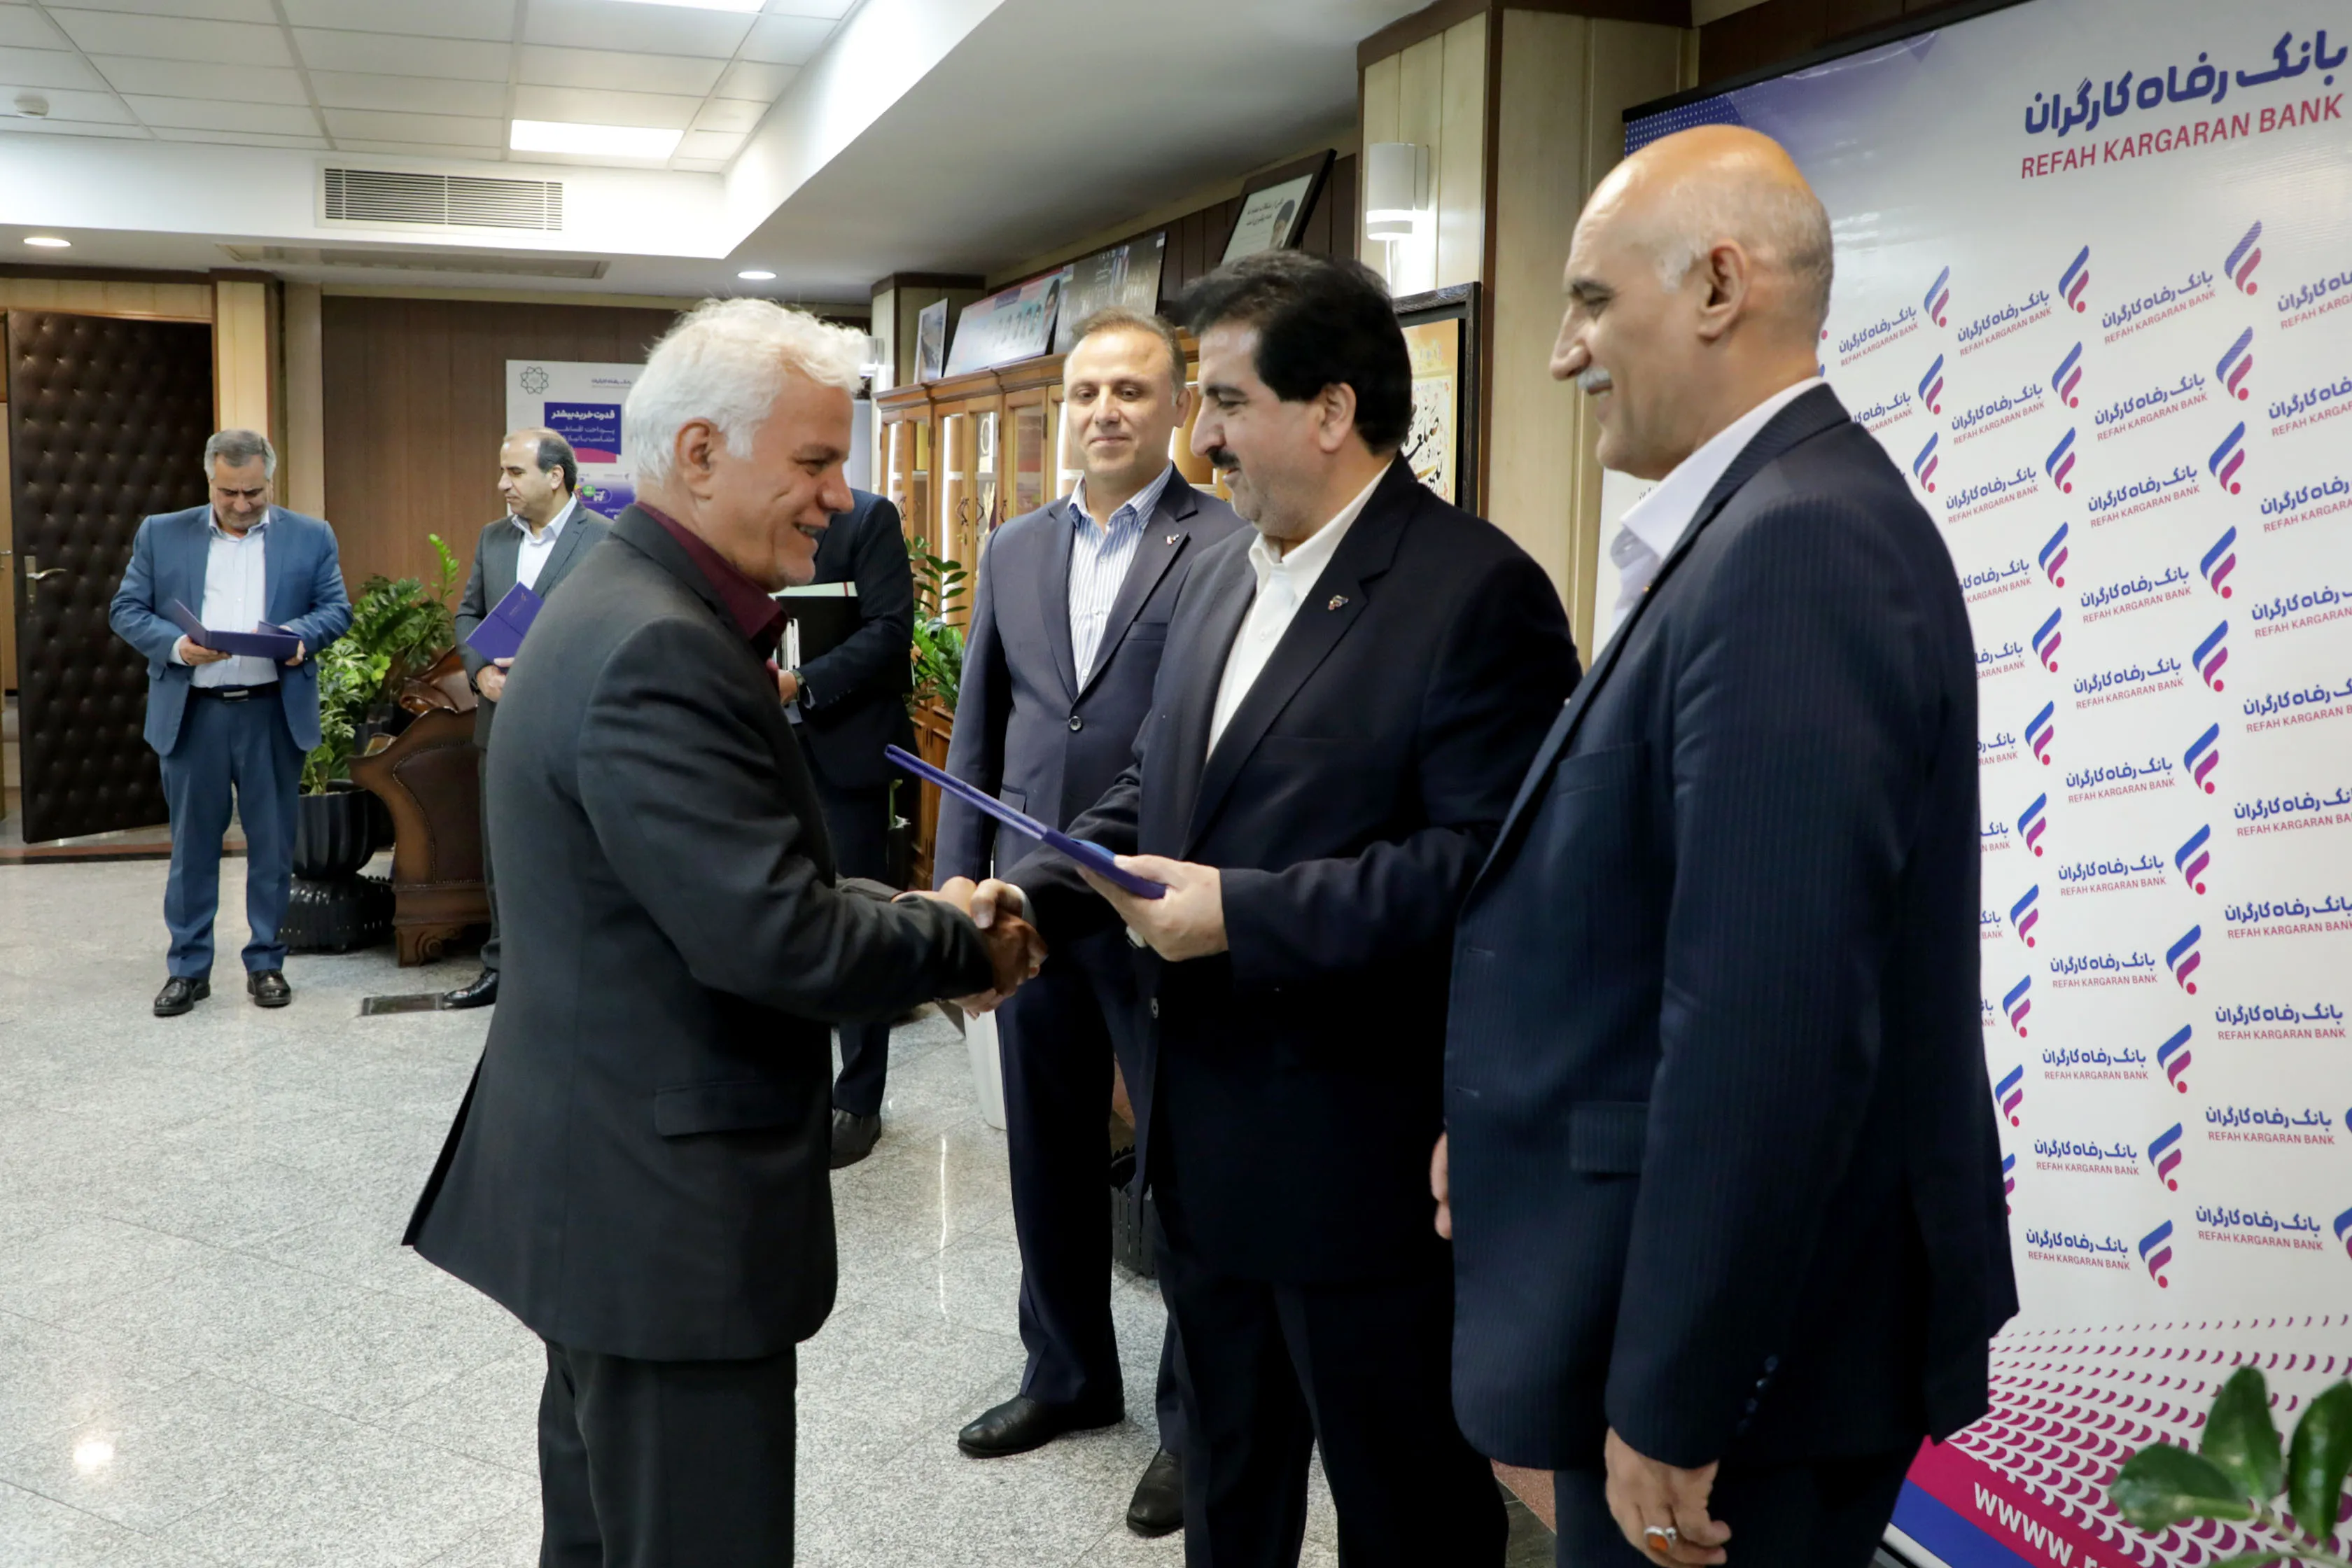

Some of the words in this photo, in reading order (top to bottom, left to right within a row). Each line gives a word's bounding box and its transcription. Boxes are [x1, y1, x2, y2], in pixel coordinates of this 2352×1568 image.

[2236, 29, 2348, 87] بانک
[2136, 52, 2228, 109] رفاه
[2025, 71, 2133, 137] کارگران
[2022, 144, 2096, 178] REFAH
[2104, 113, 2250, 162] KARGARAN
[2260, 93, 2344, 133] BANK
[2177, 271, 2213, 295] بانک
[2020, 290, 2050, 312] بانک
[2143, 286, 2176, 310] رفاه
[2278, 278, 2327, 312] کارگران
[1891, 307, 1917, 326] بانک
[1991, 304, 2019, 325] رفاه
[2102, 298, 2142, 328] کارگران
[2105, 326, 2134, 344] REFAH
[2136, 302, 2188, 330] KARGARAN
[2188, 289, 2216, 307] BANK
[2281, 308, 2317, 329] REFAH
[1868, 319, 1891, 339] رفاه
[1958, 315, 1991, 342] کارگران
[1960, 340, 1984, 357] REFAH
[1984, 318, 2028, 346] KARGARAN
[2029, 307, 2052, 323] BANK
[1839, 328, 1868, 353] کارگران
[1840, 351, 1861, 366] REFAH
[1861, 332, 1898, 356] KARGARAN
[1899, 321, 1919, 336] BANK
[2013, 384, 2043, 404] بانک
[2169, 374, 2205, 396] بانک
[1985, 396, 2012, 416] رفاه
[2136, 387, 2168, 409] رفاه
[2269, 388, 2317, 419] کارگران
[1952, 405, 1984, 430] کارگران
[2095, 398, 2134, 425] کارگران
[2098, 424, 2126, 440] REFAH
[2128, 404, 2179, 429] KARGARAN
[2180, 393, 2208, 409] BANK
[1954, 430, 1978, 444] REFAH
[1978, 412, 2022, 434] KARGARAN
[2022, 401, 2045, 416] BANK
[2272, 418, 2306, 437] REFAH
[2008, 468, 2036, 486] بانک
[2162, 465, 2197, 486] بانک
[1980, 477, 2006, 496] رفاه
[2129, 477, 2160, 498] رفاه
[2311, 476, 2349, 499] رفاه
[1947, 486, 1979, 509] کارگران
[1948, 511, 1972, 524] REFAH
[1973, 493, 2016, 514] KARGARAN
[2017, 484, 2039, 498] BANK
[2089, 485, 2127, 511] کارگران
[2090, 512, 2120, 526] REFAH
[2121, 494, 2171, 517] KARGARAN
[2174, 484, 2200, 500] BANK
[2261, 486, 2309, 514] کارگران
[2263, 515, 2300, 532] REFAH
[1973, 568, 2000, 586] رفاه
[2001, 559, 2029, 577] بانک
[2155, 567, 2189, 586] بانک
[1967, 584, 2008, 603] KARGARAN
[2010, 578, 2032, 592] BANK
[2081, 583, 2120, 607] کارگران
[2121, 576, 2152, 596] رفاه
[2083, 610, 2112, 623] REFAH
[2113, 594, 2164, 615] KARGARAN
[2165, 587, 2191, 601] BANK
[2252, 594, 2299, 620] کارگران
[2301, 586, 2340, 608] رفاه
[2255, 622, 2290, 638] REFAH
[1994, 643, 2023, 659] بانک
[2114, 665, 2145, 683] رفاه
[2147, 658, 2181, 676] بانک
[2074, 671, 2112, 694] کارگران
[2076, 696, 2104, 709] REFAH
[2106, 685, 2156, 703] KARGARAN
[2157, 678, 2184, 691] BANK
[2244, 691, 2290, 715] کارگران
[2292, 685, 2331, 705] رفاه
[2246, 718, 2281, 732] REFAH
[2283, 706, 2344, 725] KARGARAN
[2106, 762, 2136, 780] رفاه
[2138, 757, 2173, 774] بانک
[2066, 767, 2104, 788] کارگران
[2068, 792, 2097, 803] REFAH
[2098, 783, 2148, 799] KARGARAN
[2149, 778, 2176, 790] BANK
[2234, 797, 2281, 820] کارگران
[2283, 792, 2320, 812] رفاه
[2237, 825, 2272, 836] REFAH
[2273, 816, 2334, 832] KARGARAN
[2059, 862, 2096, 882] کارگران
[2098, 858, 2129, 876] رفاه
[2130, 855, 2164, 873] بانک
[2061, 886, 2088, 896] REFAH
[2090, 879, 2138, 892] KARGARAN
[2140, 876, 2166, 888] BANK
[2225, 902, 2271, 923] کارگران
[2273, 899, 2310, 918] رفاه
[2227, 928, 2261, 939] REFAH
[2263, 923, 2323, 935] KARGARAN
[2050, 955, 2088, 974] کارگران
[2090, 953, 2120, 972] رفاه
[2122, 952, 2155, 971] بانک
[2052, 979, 2081, 988] REFAH
[2081, 976, 2131, 986] KARGARAN
[2131, 974, 2157, 985] BANK
[2216, 1004, 2261, 1026] کارگران
[2262, 1004, 2300, 1023] رفاه
[2302, 1002, 2343, 1025] بانک
[2218, 1030, 2251, 1040] REFAH
[2254, 1029, 2312, 1040] KARGARAN
[2315, 1028, 2346, 1039] BANK
[2043, 1048, 2079, 1066] کارگران
[2081, 1049, 2111, 1066] رفاه
[2113, 1048, 2146, 1068] بانک
[2045, 1071, 2072, 1079] REFAH
[2073, 1071, 2122, 1080] KARGARAN
[2122, 1070, 2149, 1080] BANK
[2206, 1106, 2251, 1127] کارگران
[2253, 1108, 2289, 1128] رفاه
[2291, 1109, 2332, 1131] بانک
[2208, 1131, 2241, 1141] REFAH
[2244, 1133, 2302, 1144] KARGARAN
[2304, 1135, 2334, 1145] BANK
[2034, 1140, 2071, 1158] کارگران
[2073, 1142, 2103, 1160] رفاه
[2104, 1142, 2137, 1163] بانک
[2036, 1161, 2064, 1170] REFAH
[2064, 1164, 2113, 1174] KARGARAN
[2114, 1166, 2138, 1175] BANK
[2196, 1205, 2241, 1228] کارگران
[2242, 1211, 2279, 1232] رفاه
[2281, 1213, 2320, 1237] بانک
[2026, 1229, 2063, 1249] کارگران
[2064, 1234, 2094, 1252] رفاه
[2096, 1237, 2128, 1258] بانک
[2199, 1231, 2232, 1242] REFAH
[2232, 1234, 2291, 1248] KARGARAN
[2292, 1239, 2323, 1250] BANK
[2029, 1252, 2056, 1262] REFAH
[2056, 1254, 2105, 1268] KARGARAN
[2105, 1259, 2130, 1270] BANK
